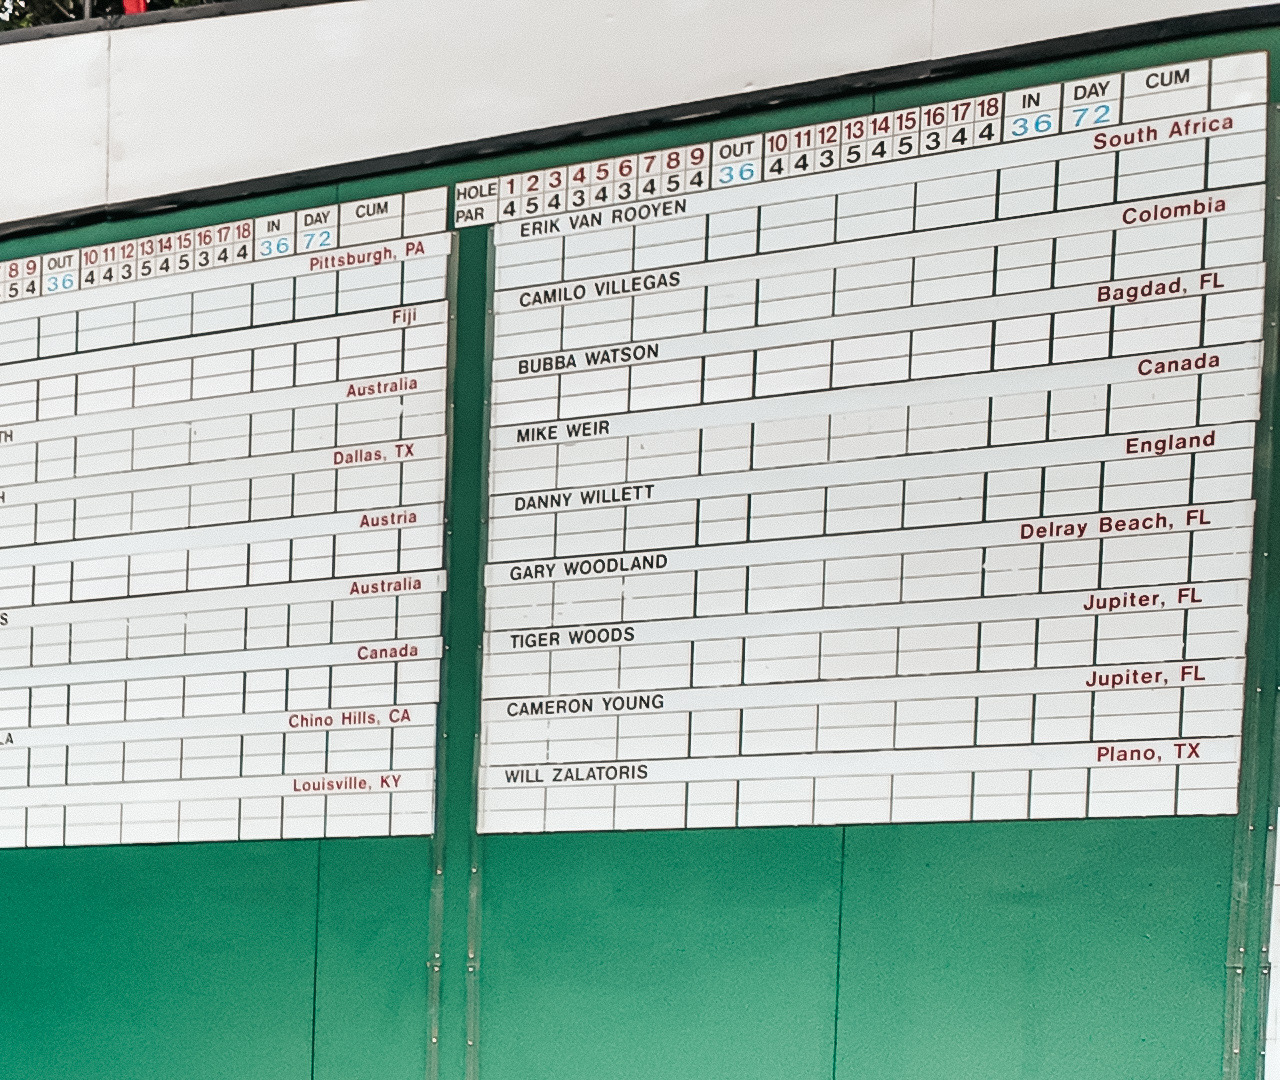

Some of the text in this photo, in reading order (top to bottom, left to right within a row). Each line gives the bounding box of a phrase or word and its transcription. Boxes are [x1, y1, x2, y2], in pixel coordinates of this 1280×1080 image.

[456, 68, 1190, 201] HOLE 1 2 3 4 5 6 7 8 9 OUT 10 11 12 13 14 15 16 17 18 IN DAY CUM
[1094, 117, 1233, 150] South Africa
[455, 105, 1110, 223] PAR 4 5 4 3 4 3 4 5 4 36 4 4 3 5 4 5 3 4 4 36 72
[520, 199, 686, 237] ERIK VAN ROOYEN
[1122, 197, 1226, 224] Colombia
[310, 241, 425, 275] Pittsburgh, PA
[519, 271, 680, 307] CAMILO VILLEGAS
[1098, 272, 1224, 302] Bagdad, FL
[392, 308, 416, 326] Fiji
[518, 343, 659, 374] BUBBA WATSON
[1138, 353, 1219, 376] Canada
[346, 378, 417, 401] Australia
[517, 420, 609, 444] MIKE WEIR
[1126, 430, 1215, 454] England
[334, 443, 414, 467] Dallas, TX
[515, 484, 655, 511] DANNY WILLETT
[360, 512, 417, 528] Austria
[1021, 509, 1211, 539] Delray Beach, FL
[510, 554, 667, 581] GARY WOODLAND
[350, 577, 421, 595] Australia
[1083, 587, 1202, 612] Jupiter, FL
[510, 627, 634, 648] TIGER WOODS
[357, 644, 418, 660] Canada
[1086, 665, 1205, 689] Jupiter, FL
[507, 694, 664, 717] CAMERON YOUNG
[289, 709, 411, 729] Chino Hills, CA
[1097, 743, 1200, 762] Plano, TX
[293, 775, 401, 792] Louisville, KY
[505, 764, 648, 783] WILL ZALATORIS
